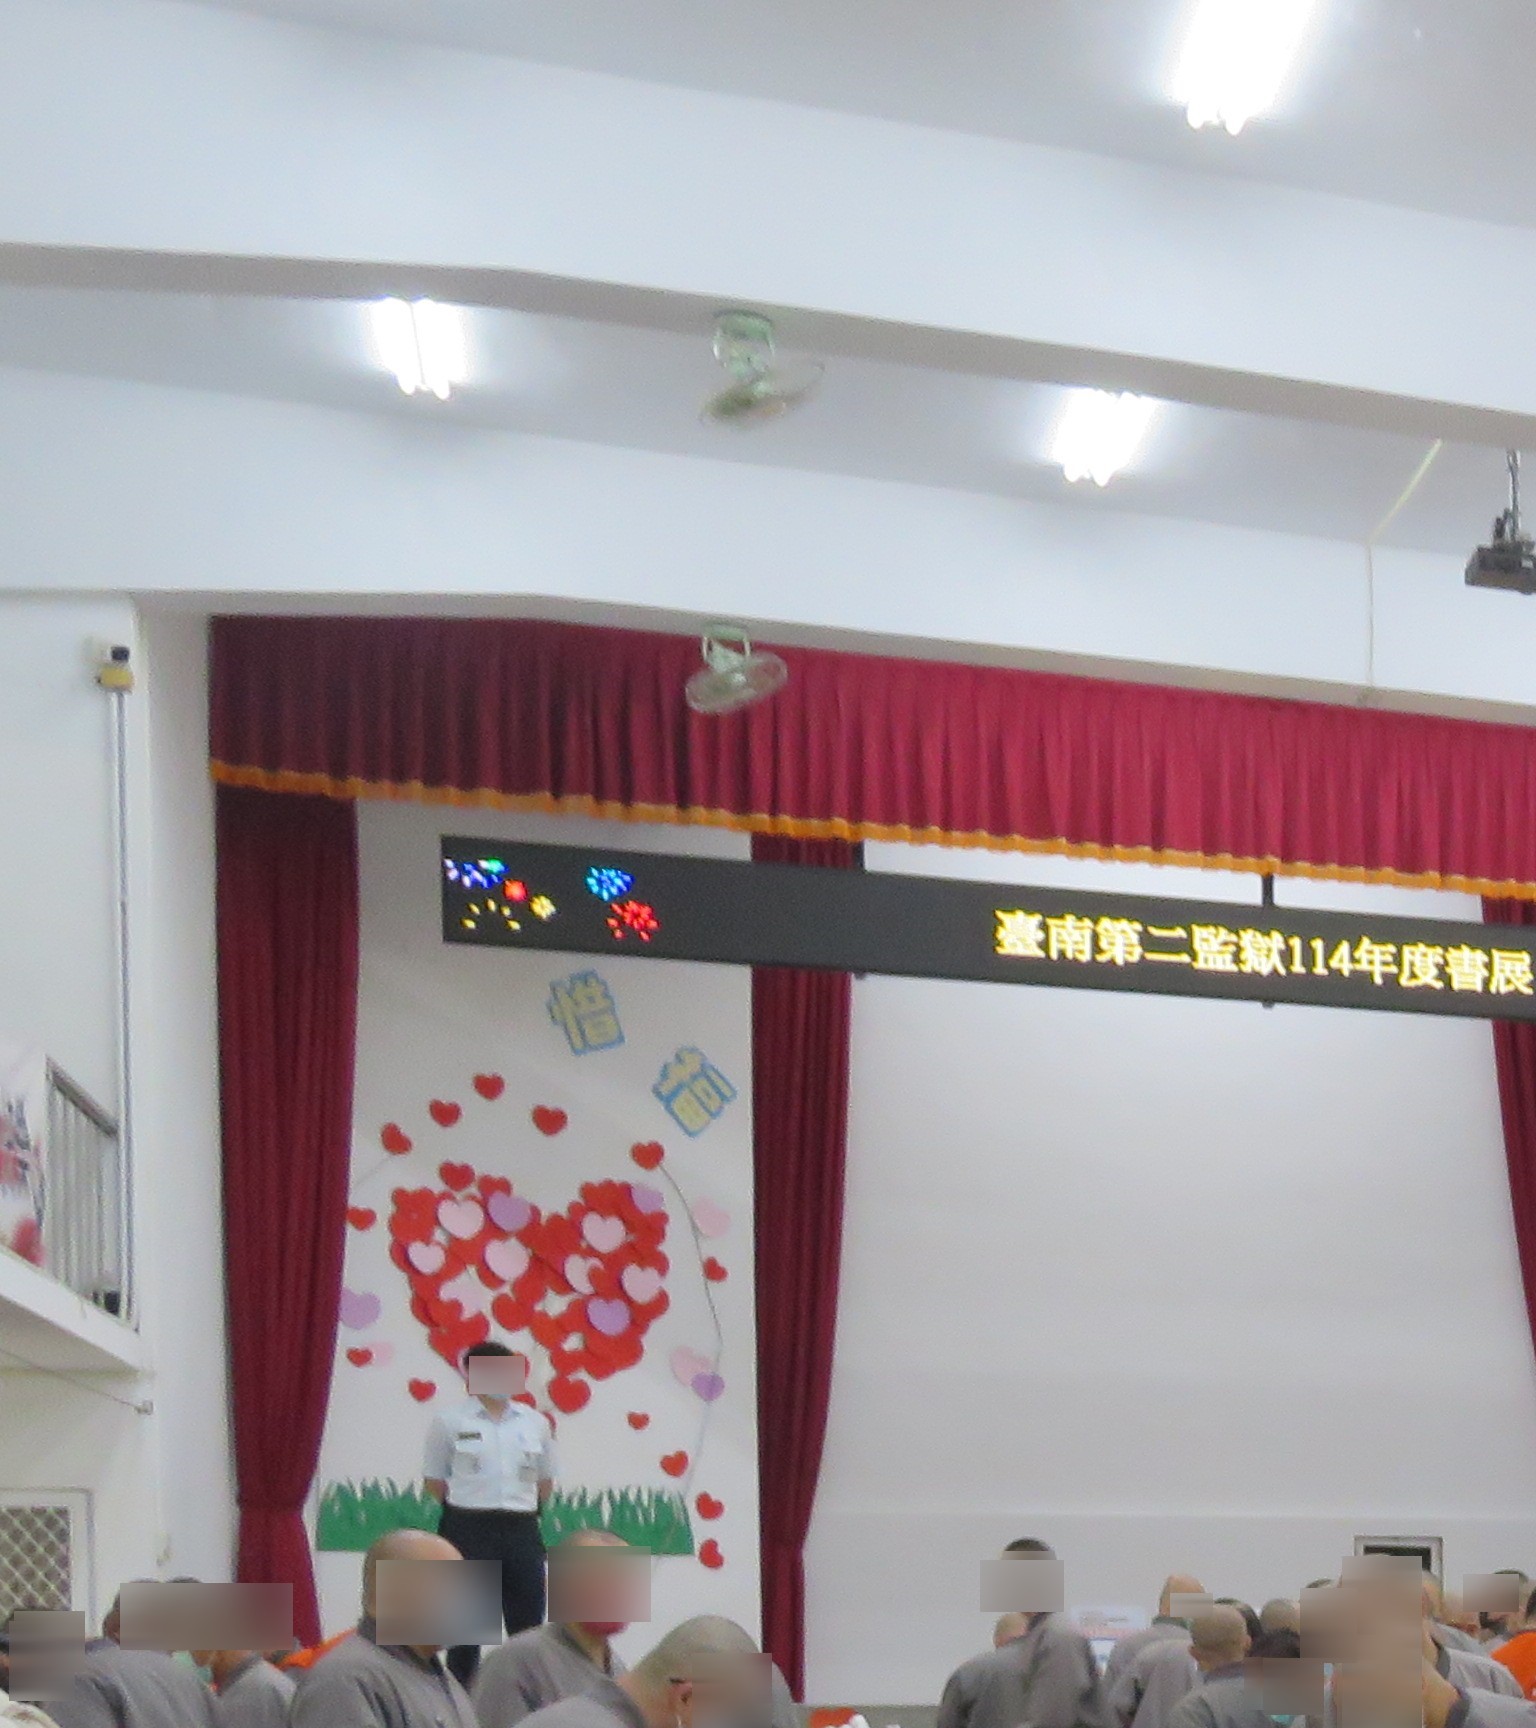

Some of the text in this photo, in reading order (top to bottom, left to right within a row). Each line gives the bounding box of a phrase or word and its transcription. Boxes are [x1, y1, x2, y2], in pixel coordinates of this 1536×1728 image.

[994, 909, 1535, 996] 臺南第二監獄114年度書展
